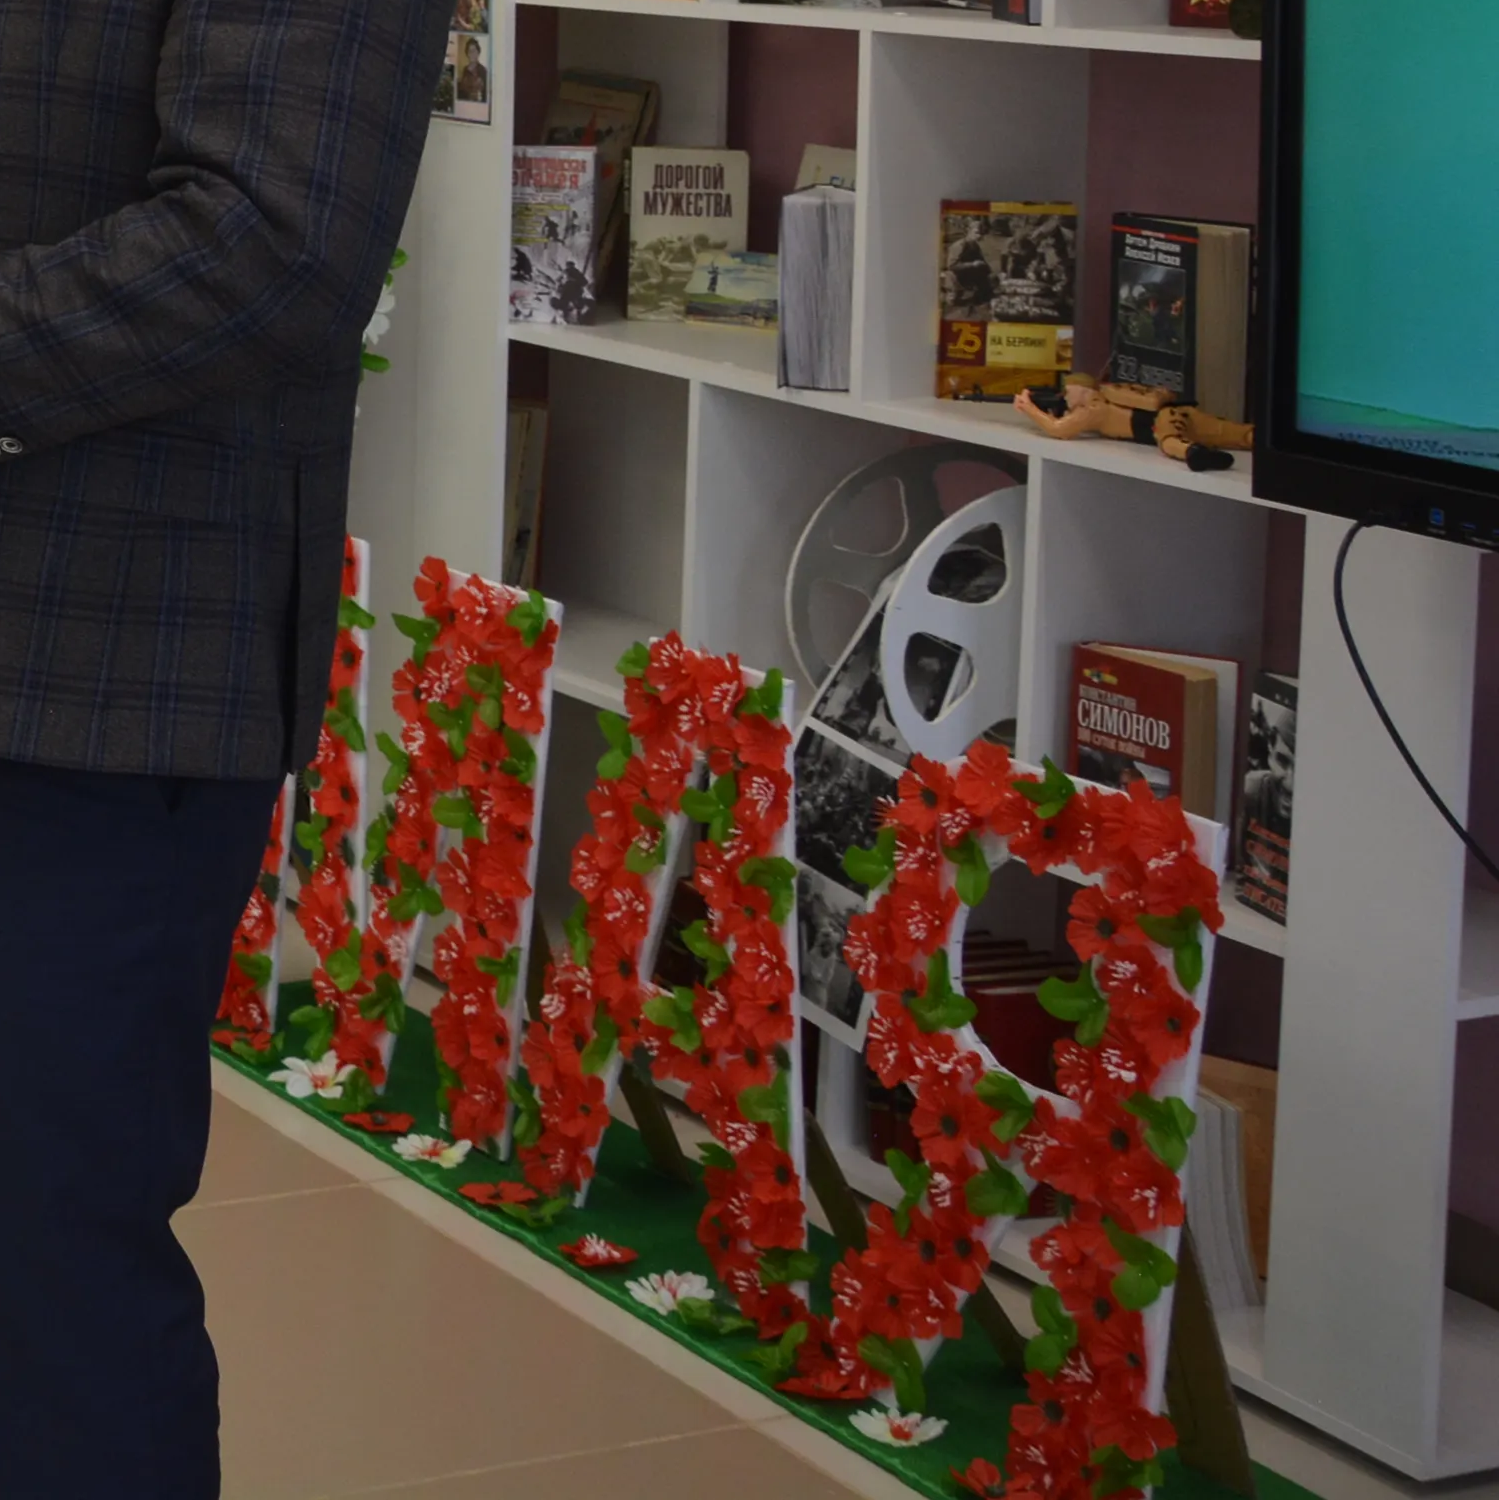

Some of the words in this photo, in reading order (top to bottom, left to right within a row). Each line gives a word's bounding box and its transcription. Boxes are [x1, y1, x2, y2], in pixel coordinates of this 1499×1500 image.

[651, 162, 726, 192] ДОРОГОЙ
[643, 190, 733, 219] МУЖЕСТВА
[1077, 698, 1172, 751] СИМОНОВ
